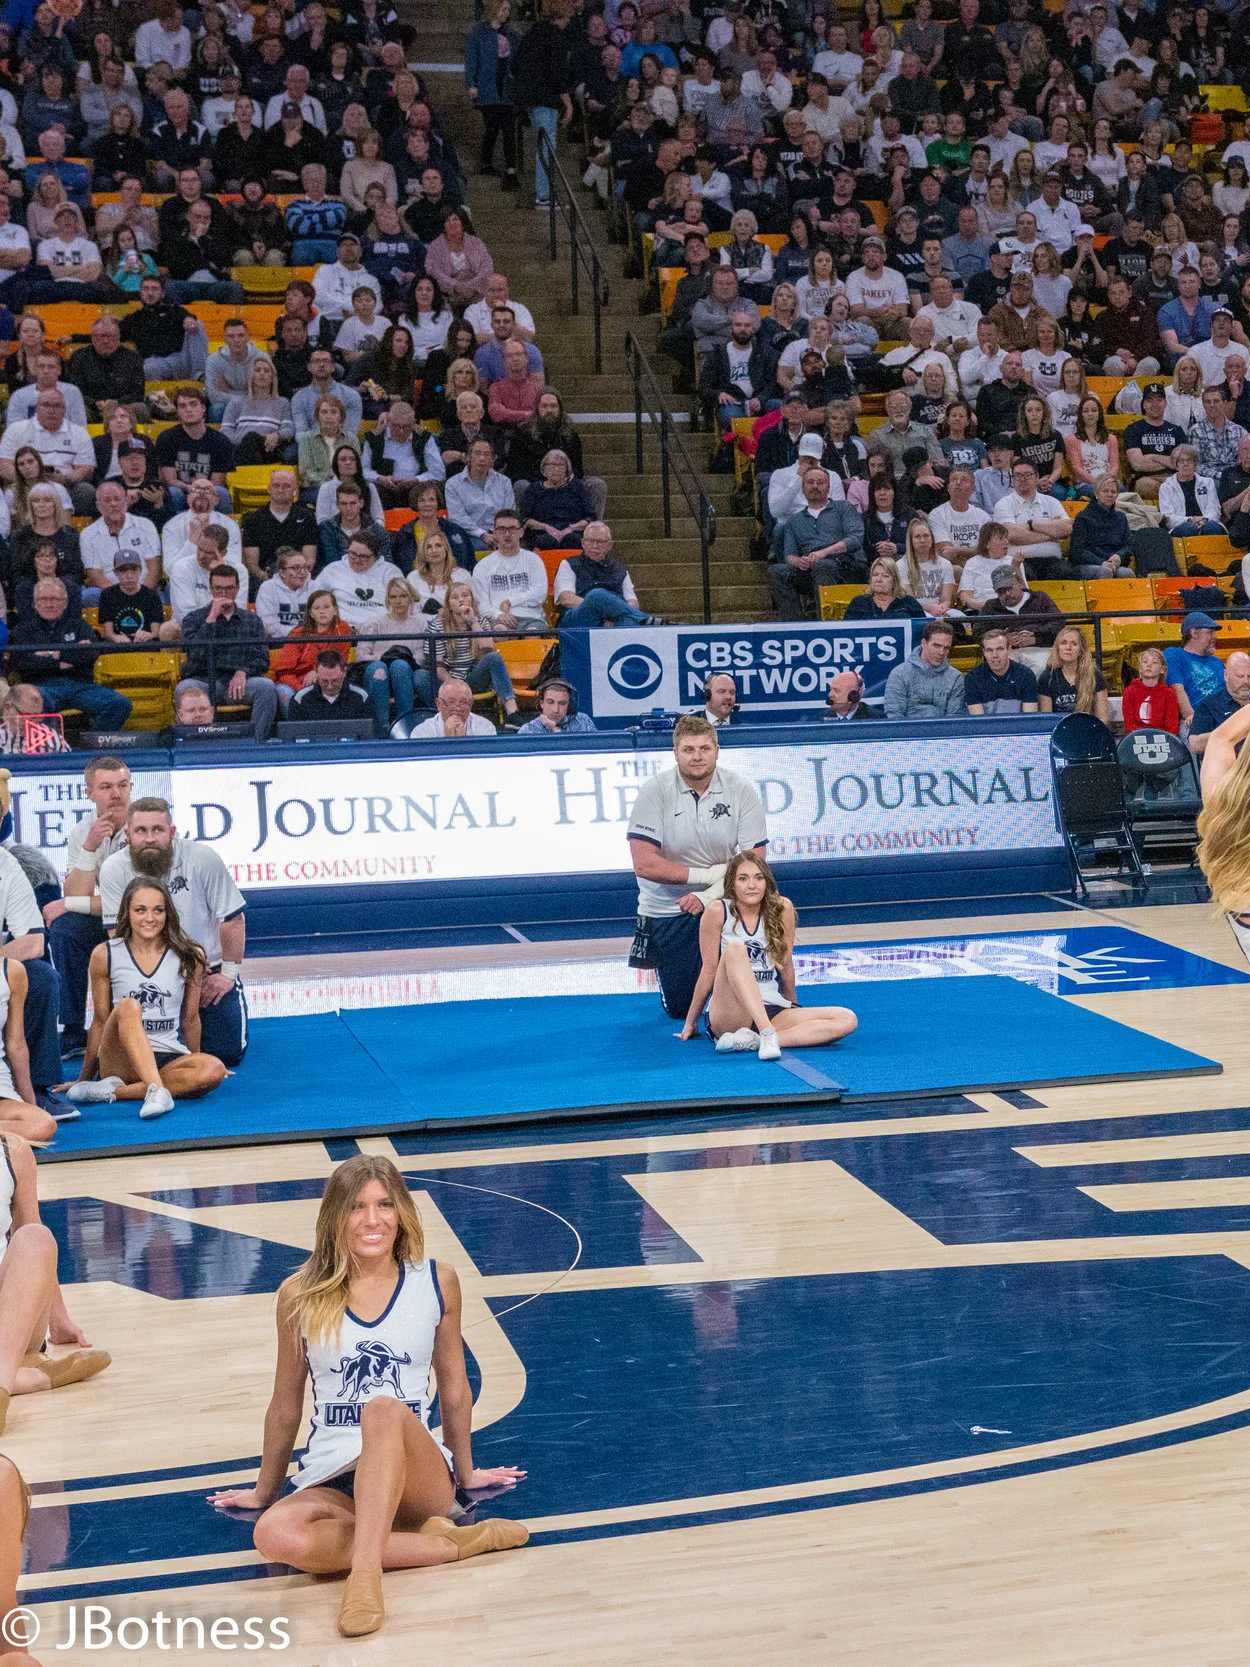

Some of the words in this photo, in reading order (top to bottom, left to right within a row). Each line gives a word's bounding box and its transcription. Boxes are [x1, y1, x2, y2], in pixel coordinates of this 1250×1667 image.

[175, 461, 211, 474] STATE
[953, 533, 978, 541] HOOPS
[685, 640, 752, 669] CBS
[761, 635, 897, 666] SPORTS
[687, 664, 866, 697] NTWOR
[97, 735, 137, 744] DVSPORT
[616, 759, 662, 778] THE
[39, 783, 88, 802] THE
[806, 755, 1049, 826] JOURNAL
[248, 780, 517, 852] JOURNAL
[794, 834, 835, 855] THE
[841, 826, 980, 852] COMMUNITY
[228, 862, 278, 883] THE
[284, 854, 437, 881] COMMUNITY
[146, 1018, 175, 1032] STATE
